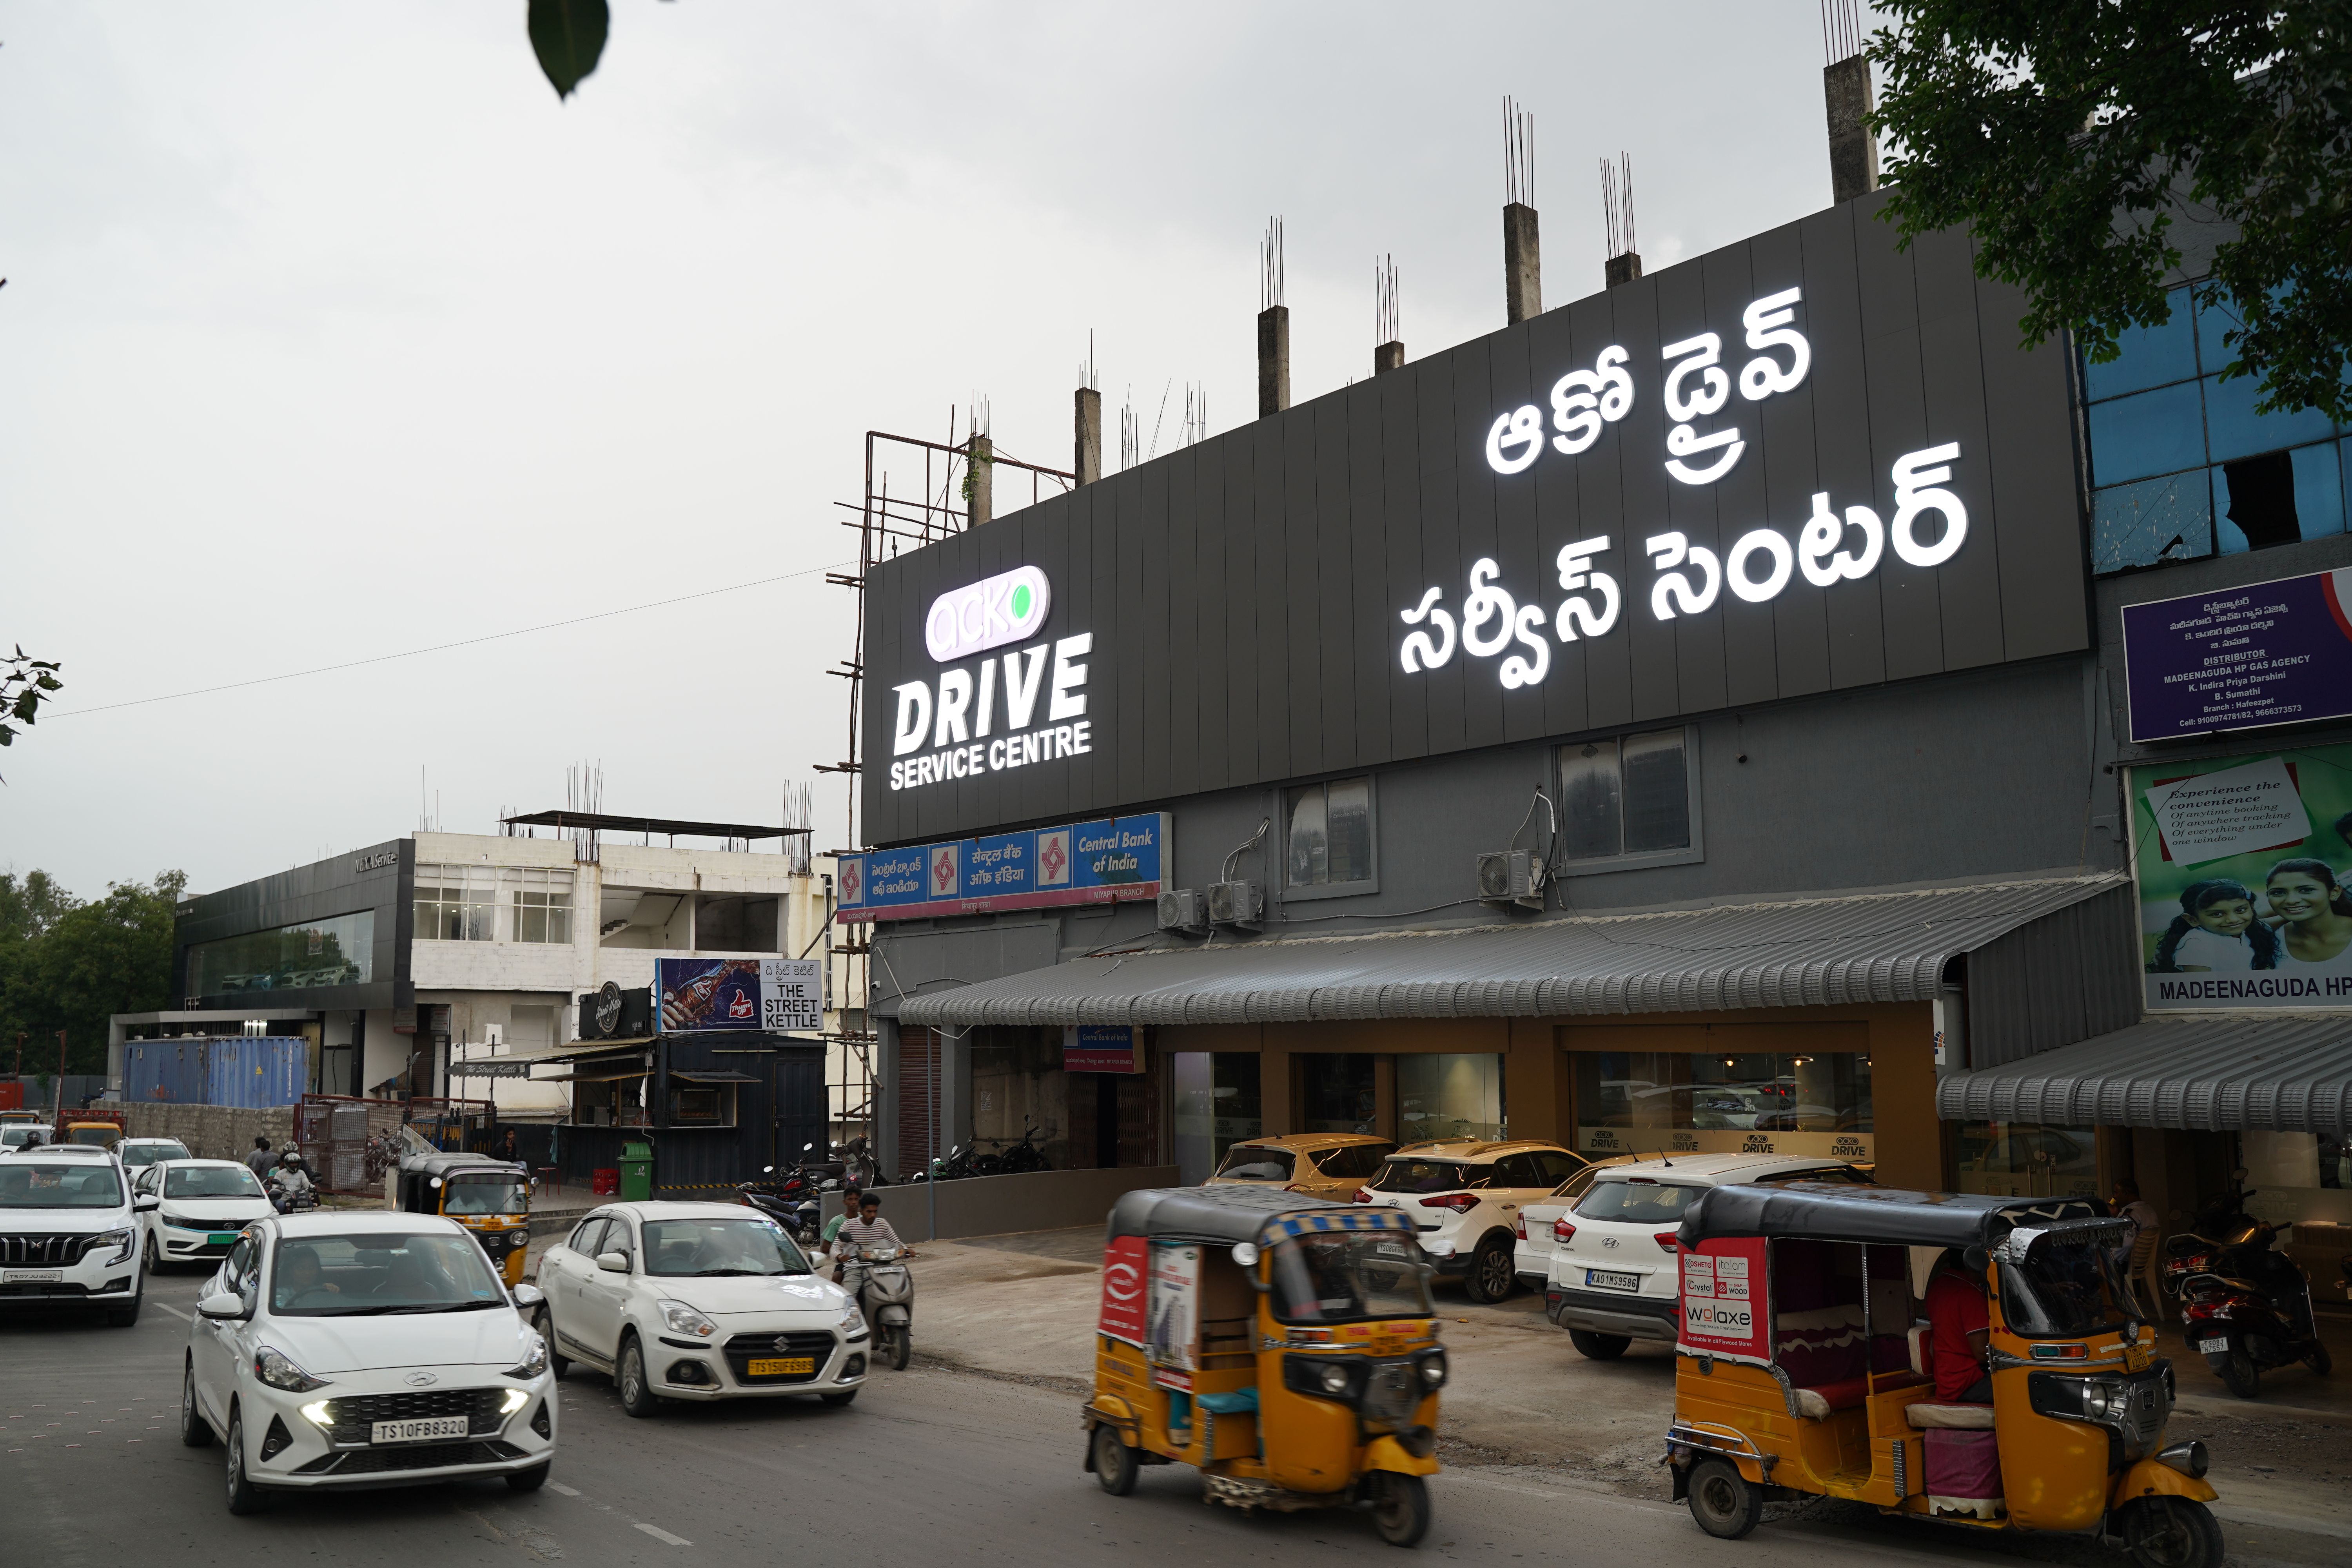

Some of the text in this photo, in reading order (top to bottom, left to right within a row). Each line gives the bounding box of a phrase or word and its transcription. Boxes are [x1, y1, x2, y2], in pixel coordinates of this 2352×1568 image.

[1486, 287, 1811, 485] ఆకో డ్రైవ్
[1400, 442, 1969, 690] సర్వీస్ సెంటర్
[2203, 649, 2265, 665] DISTRIBUTOR
[2164, 655, 2310, 684] MADEENAGUDA HP GAS AGENCY
[2200, 681, 2224, 690] Indira
[2226, 678, 2248, 689] Priya
[2250, 671, 2286, 683] Darshini
[892, 632, 1093, 756] DRIVE
[2226, 687, 2261, 699] Sumathi
[2203, 703, 2229, 713] Branch
[2236, 697, 2274, 708] Hafeezpet
[2197, 711, 2254, 724] 9100974781/82,
[2255, 704, 2302, 717] 9666373573
[891, 720, 1091, 790] SERVICE CENTRE
[2170, 782, 2281, 799] Experience the
[2170, 796, 2260, 810] convenience
[2186, 809, 2230, 819] anytime
[2234, 804, 2278, 813] booking
[2171, 812, 2291, 829] Of anywhere tracking
[2188, 825, 2245, 836] everything
[2249, 822, 2283, 830] under
[1079, 828, 1153, 853] Central Bank
[2194, 835, 2236, 844] window
[1003, 843, 1022, 859] बैंक
[356, 852, 395, 873] NEXA Service
[1093, 853, 1138, 873] of India
[995, 865, 1024, 884] इंडिया
[1094, 888, 1144, 899] MIYAPUR BRANCH
[766, 965, 772, 975] ది
[793, 965, 814, 976] కెటిల్
[777, 985, 804, 998] THE
[2160, 977, 2352, 1000] MADEENAGUDA HP
[596, 999, 621, 1020] Street Kettle
[732, 1003, 751, 1013] Thums
[765, 999, 817, 1013] STREET
[766, 1014, 818, 1027] KETTLE
[465, 1065, 517, 1073] The Street Kettle
[1591, 1139, 1619, 1148] DRIVE
[1669, 1141, 1698, 1151] DRIVE
[1743, 1143, 1774, 1153] DRIVE
[1831, 1145, 1866, 1156] DRIVE
[1685, 1259, 1711, 1268] KOSHETO
[1719, 1259, 1746, 1270] italam
[1591, 1273, 1637, 1288] KA01MS9586
[1687, 1279, 1712, 1292] Crystal
[1687, 1305, 1750, 1325] wolaxe
[2204, 1339, 2223, 1347] TS08J
[2145, 1396, 2153, 1406] RE
[381, 1421, 465, 1439] TS10FB8320
